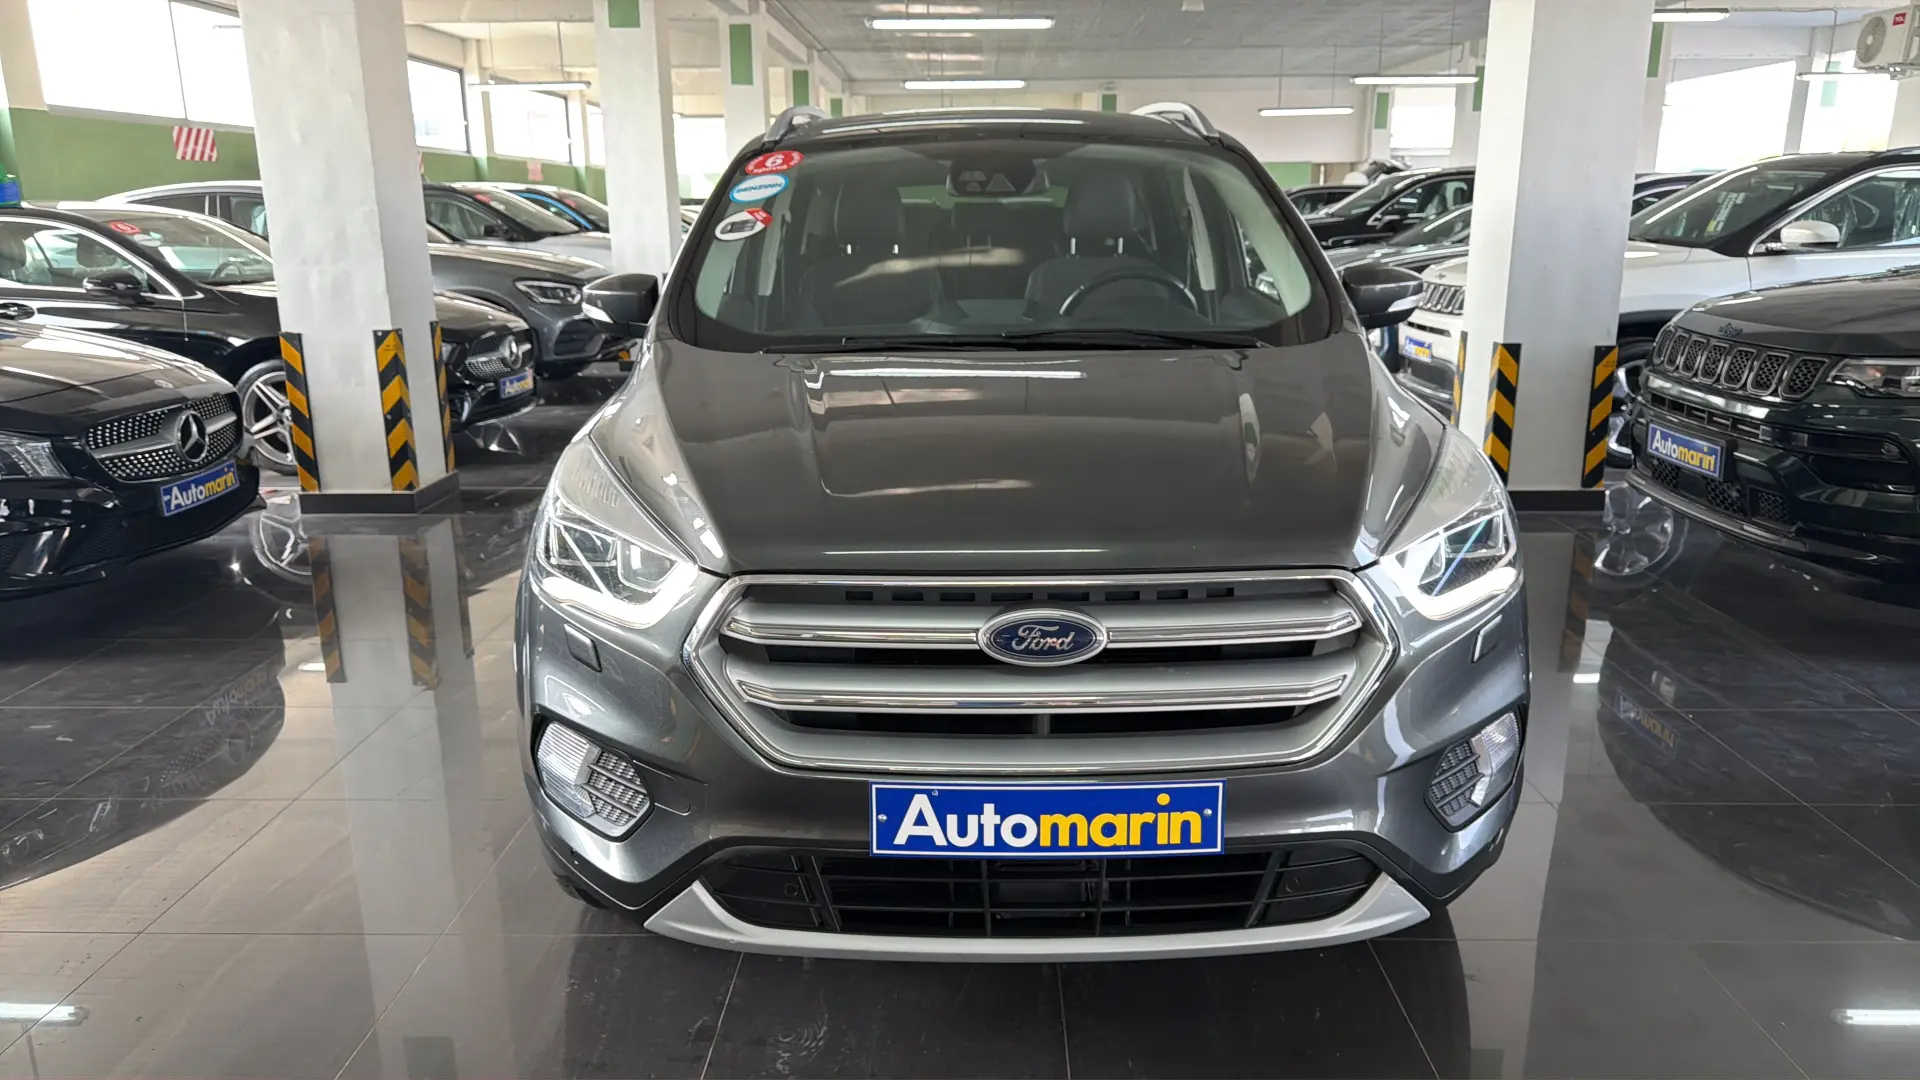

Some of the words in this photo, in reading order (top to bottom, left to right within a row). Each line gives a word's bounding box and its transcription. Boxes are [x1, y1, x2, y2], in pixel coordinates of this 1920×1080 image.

[765, 154, 784, 167] 6
[1652, 430, 1715, 471] Automarin
[170, 467, 235, 510] Automarin
[1012, 624, 1075, 650] Ford
[893, 793, 1201, 847] Automarin
